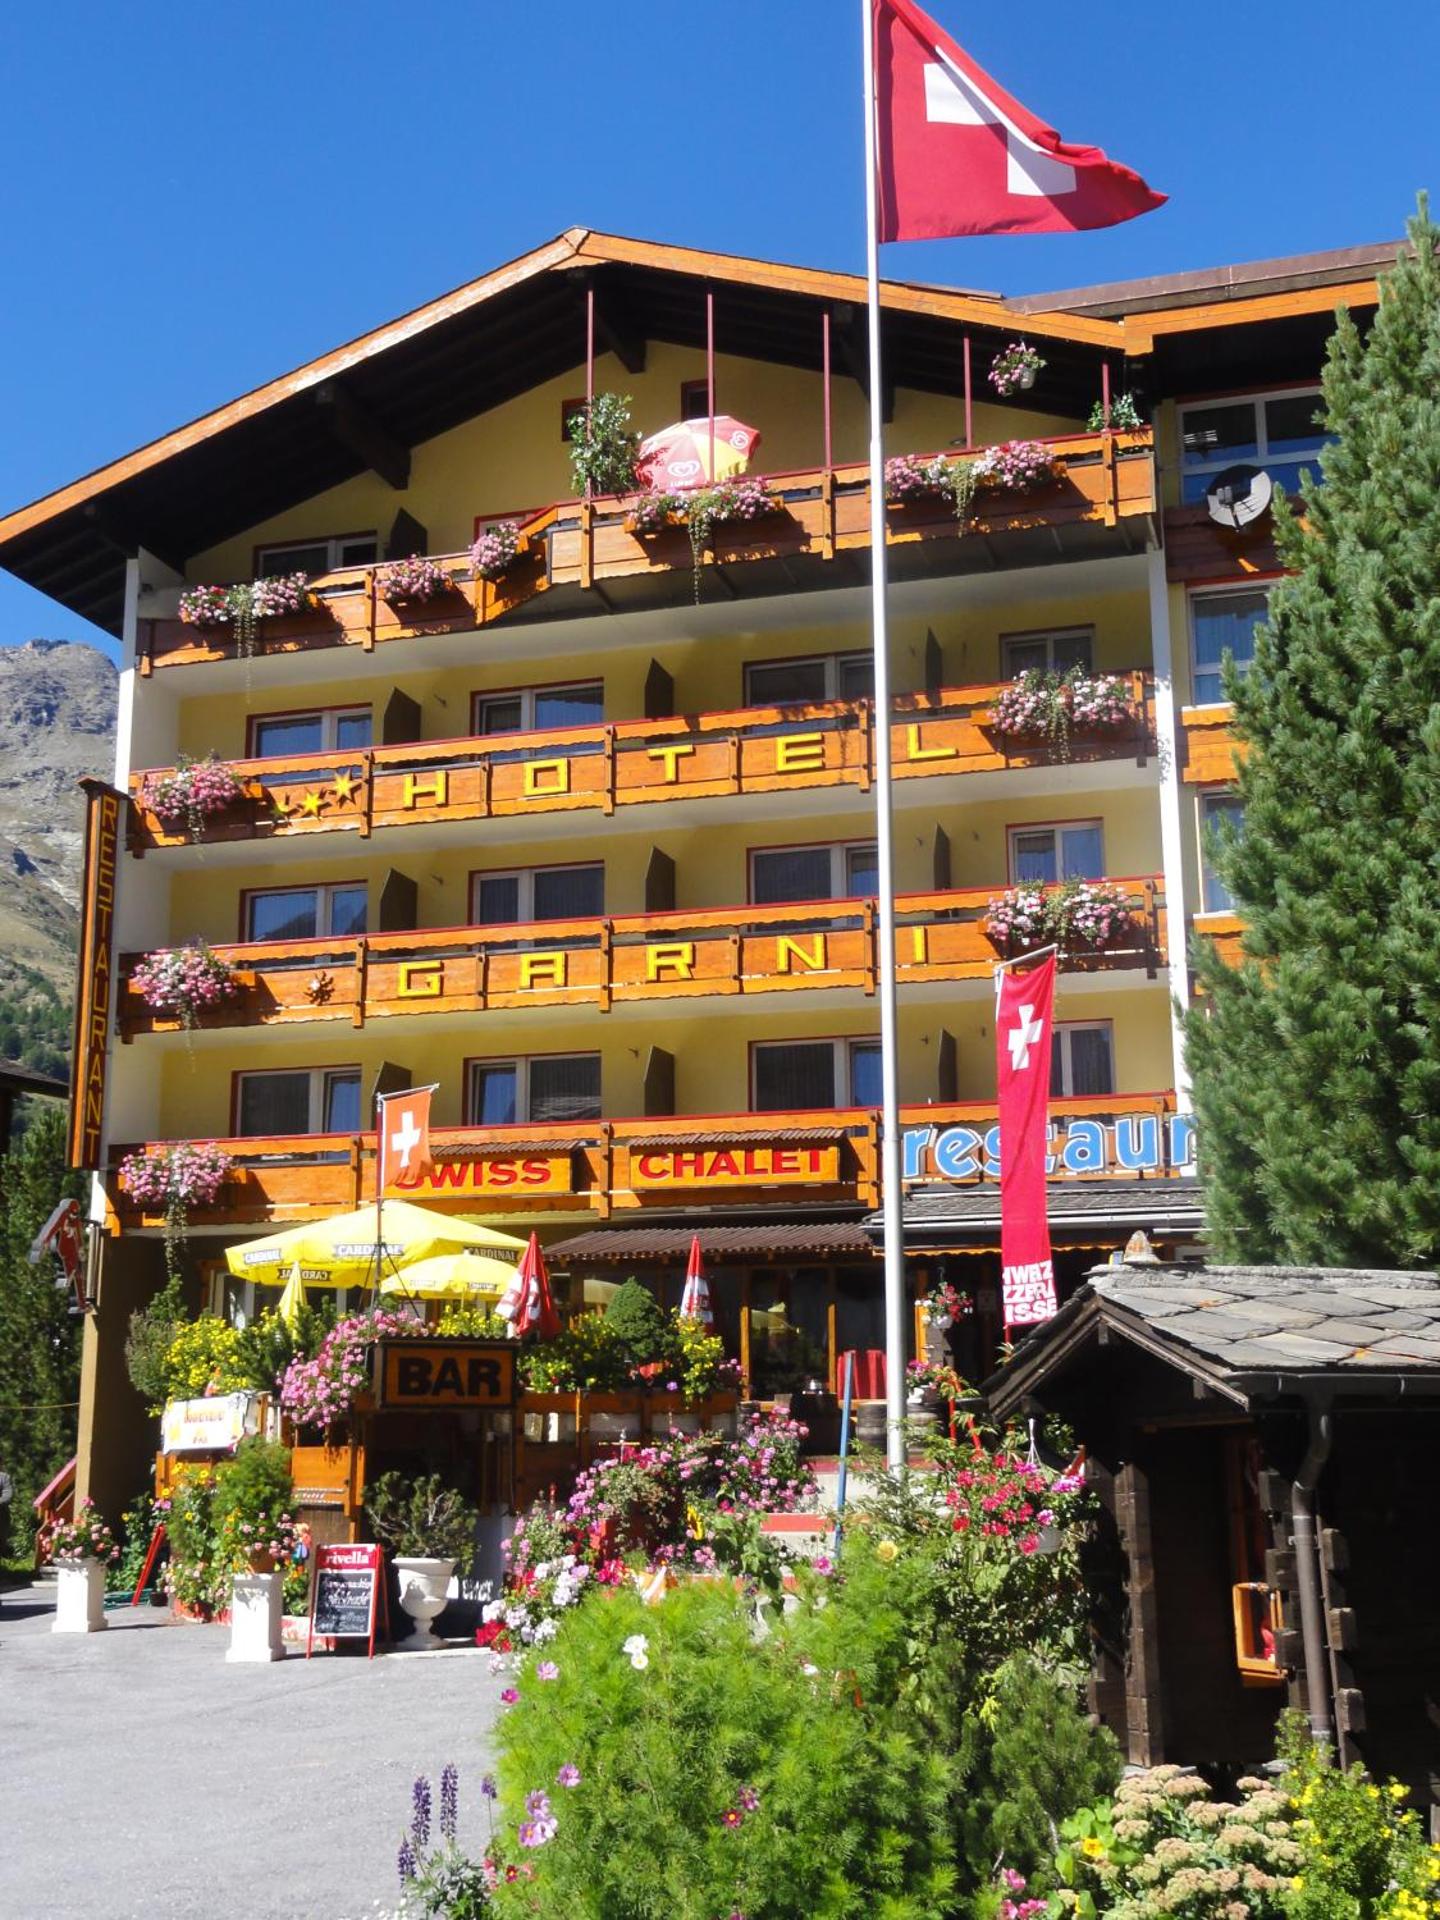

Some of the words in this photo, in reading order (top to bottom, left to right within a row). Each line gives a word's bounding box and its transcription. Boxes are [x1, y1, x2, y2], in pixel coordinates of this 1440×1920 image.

[403, 724, 957, 810] HOTEL
[86, 795, 117, 1164] RESTAURANT
[398, 926, 926, 997] GARNI
[639, 1148, 827, 1179] CHALET
[338, 1244, 402, 1256] CARDAL
[399, 1357, 501, 1397] BAR
[326, 1551, 369, 1565] rivella
